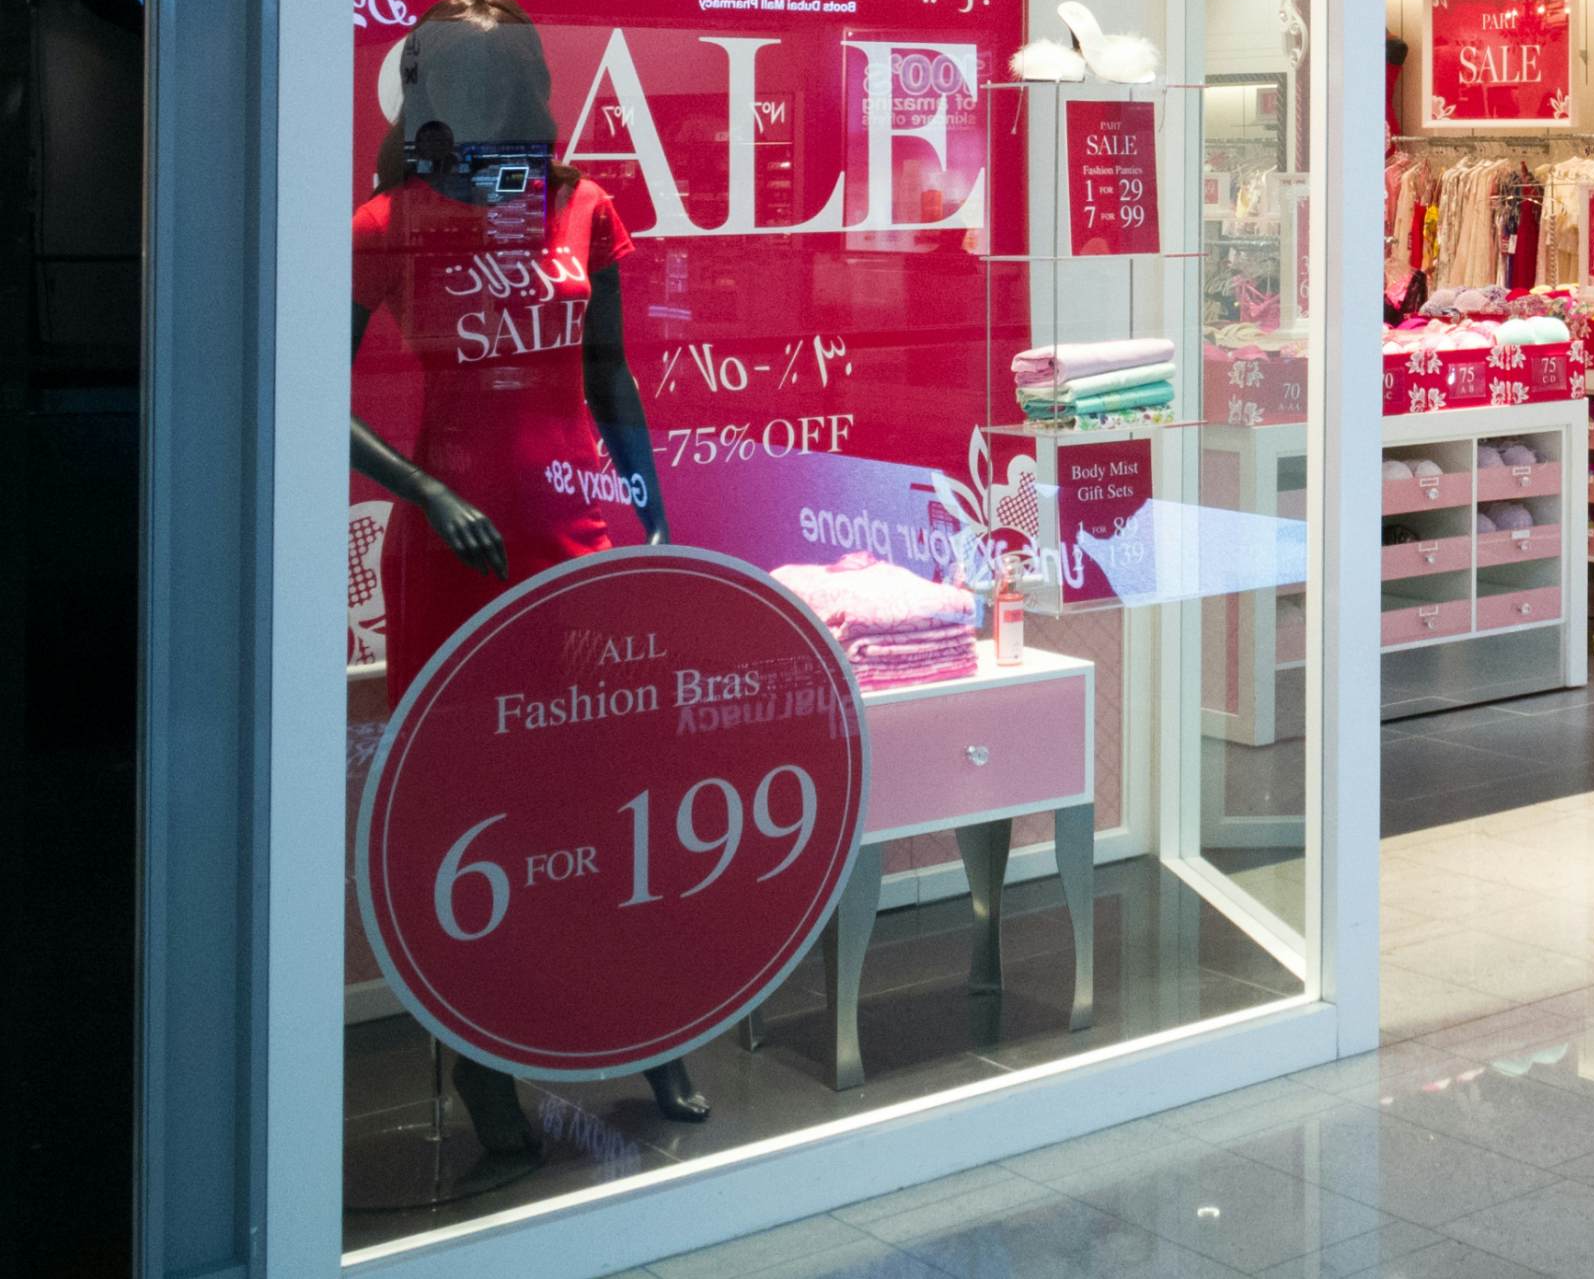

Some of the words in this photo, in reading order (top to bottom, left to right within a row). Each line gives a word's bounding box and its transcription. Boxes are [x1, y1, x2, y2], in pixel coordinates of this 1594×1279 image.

[1481, 14, 1517, 31] PART
[1459, 44, 1542, 84] SALE
[373, 27, 986, 238] ALE
[1100, 121, 1121, 131] PART
[1086, 134, 1138, 155] SALE
[1085, 179, 1094, 202] 1
[1119, 178, 1143, 201] 29
[1084, 205, 1096, 228] 7
[1120, 205, 1144, 228] 99
[445, 246, 587, 301] تنزيلات
[457, 300, 589, 363] SALE
[1459, 367, 1475, 383] 75
[1541, 357, 1556, 373] 75
[1283, 383, 1301, 400] 70
[762, 414, 854, 458] OFF
[1071, 464, 1106, 481] Body
[1110, 461, 1139, 477] Mist
[1077, 486, 1104, 502] Gift
[1107, 483, 1134, 499] Sets
[1092, 525, 1107, 534] FOR
[1113, 516, 1139, 539] 89
[1109, 542, 1144, 568] 139
[598, 632, 667, 666] ALL
[493, 682, 659, 736] Fashion
[674, 668, 761, 709] Bras
[433, 812, 512, 942] 6
[523, 846, 600, 887] FOR
[616, 764, 818, 909] 199
